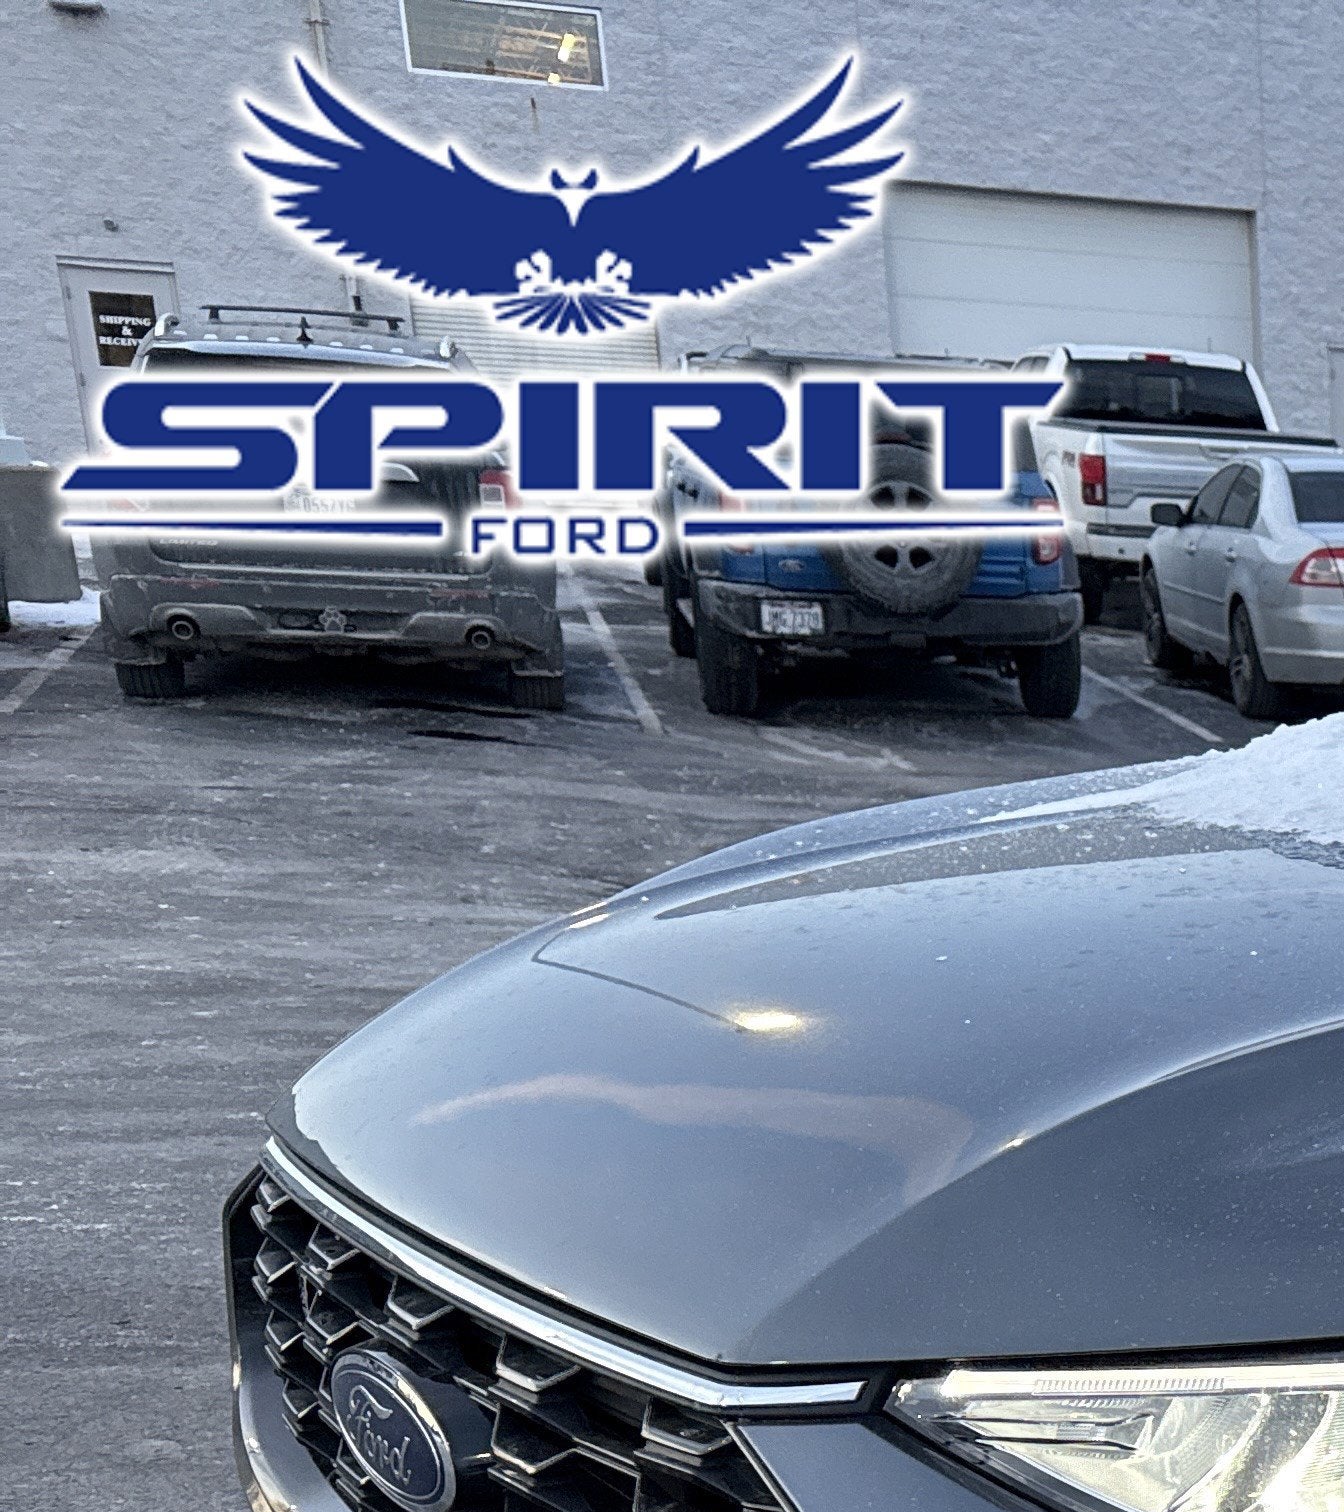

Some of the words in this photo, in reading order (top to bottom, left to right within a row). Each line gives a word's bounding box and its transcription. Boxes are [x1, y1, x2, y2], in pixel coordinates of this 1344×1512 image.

[98, 314, 152, 327] SHIPPING
[121, 325, 134, 336] &
[346, 1383, 412, 1486] Ford
